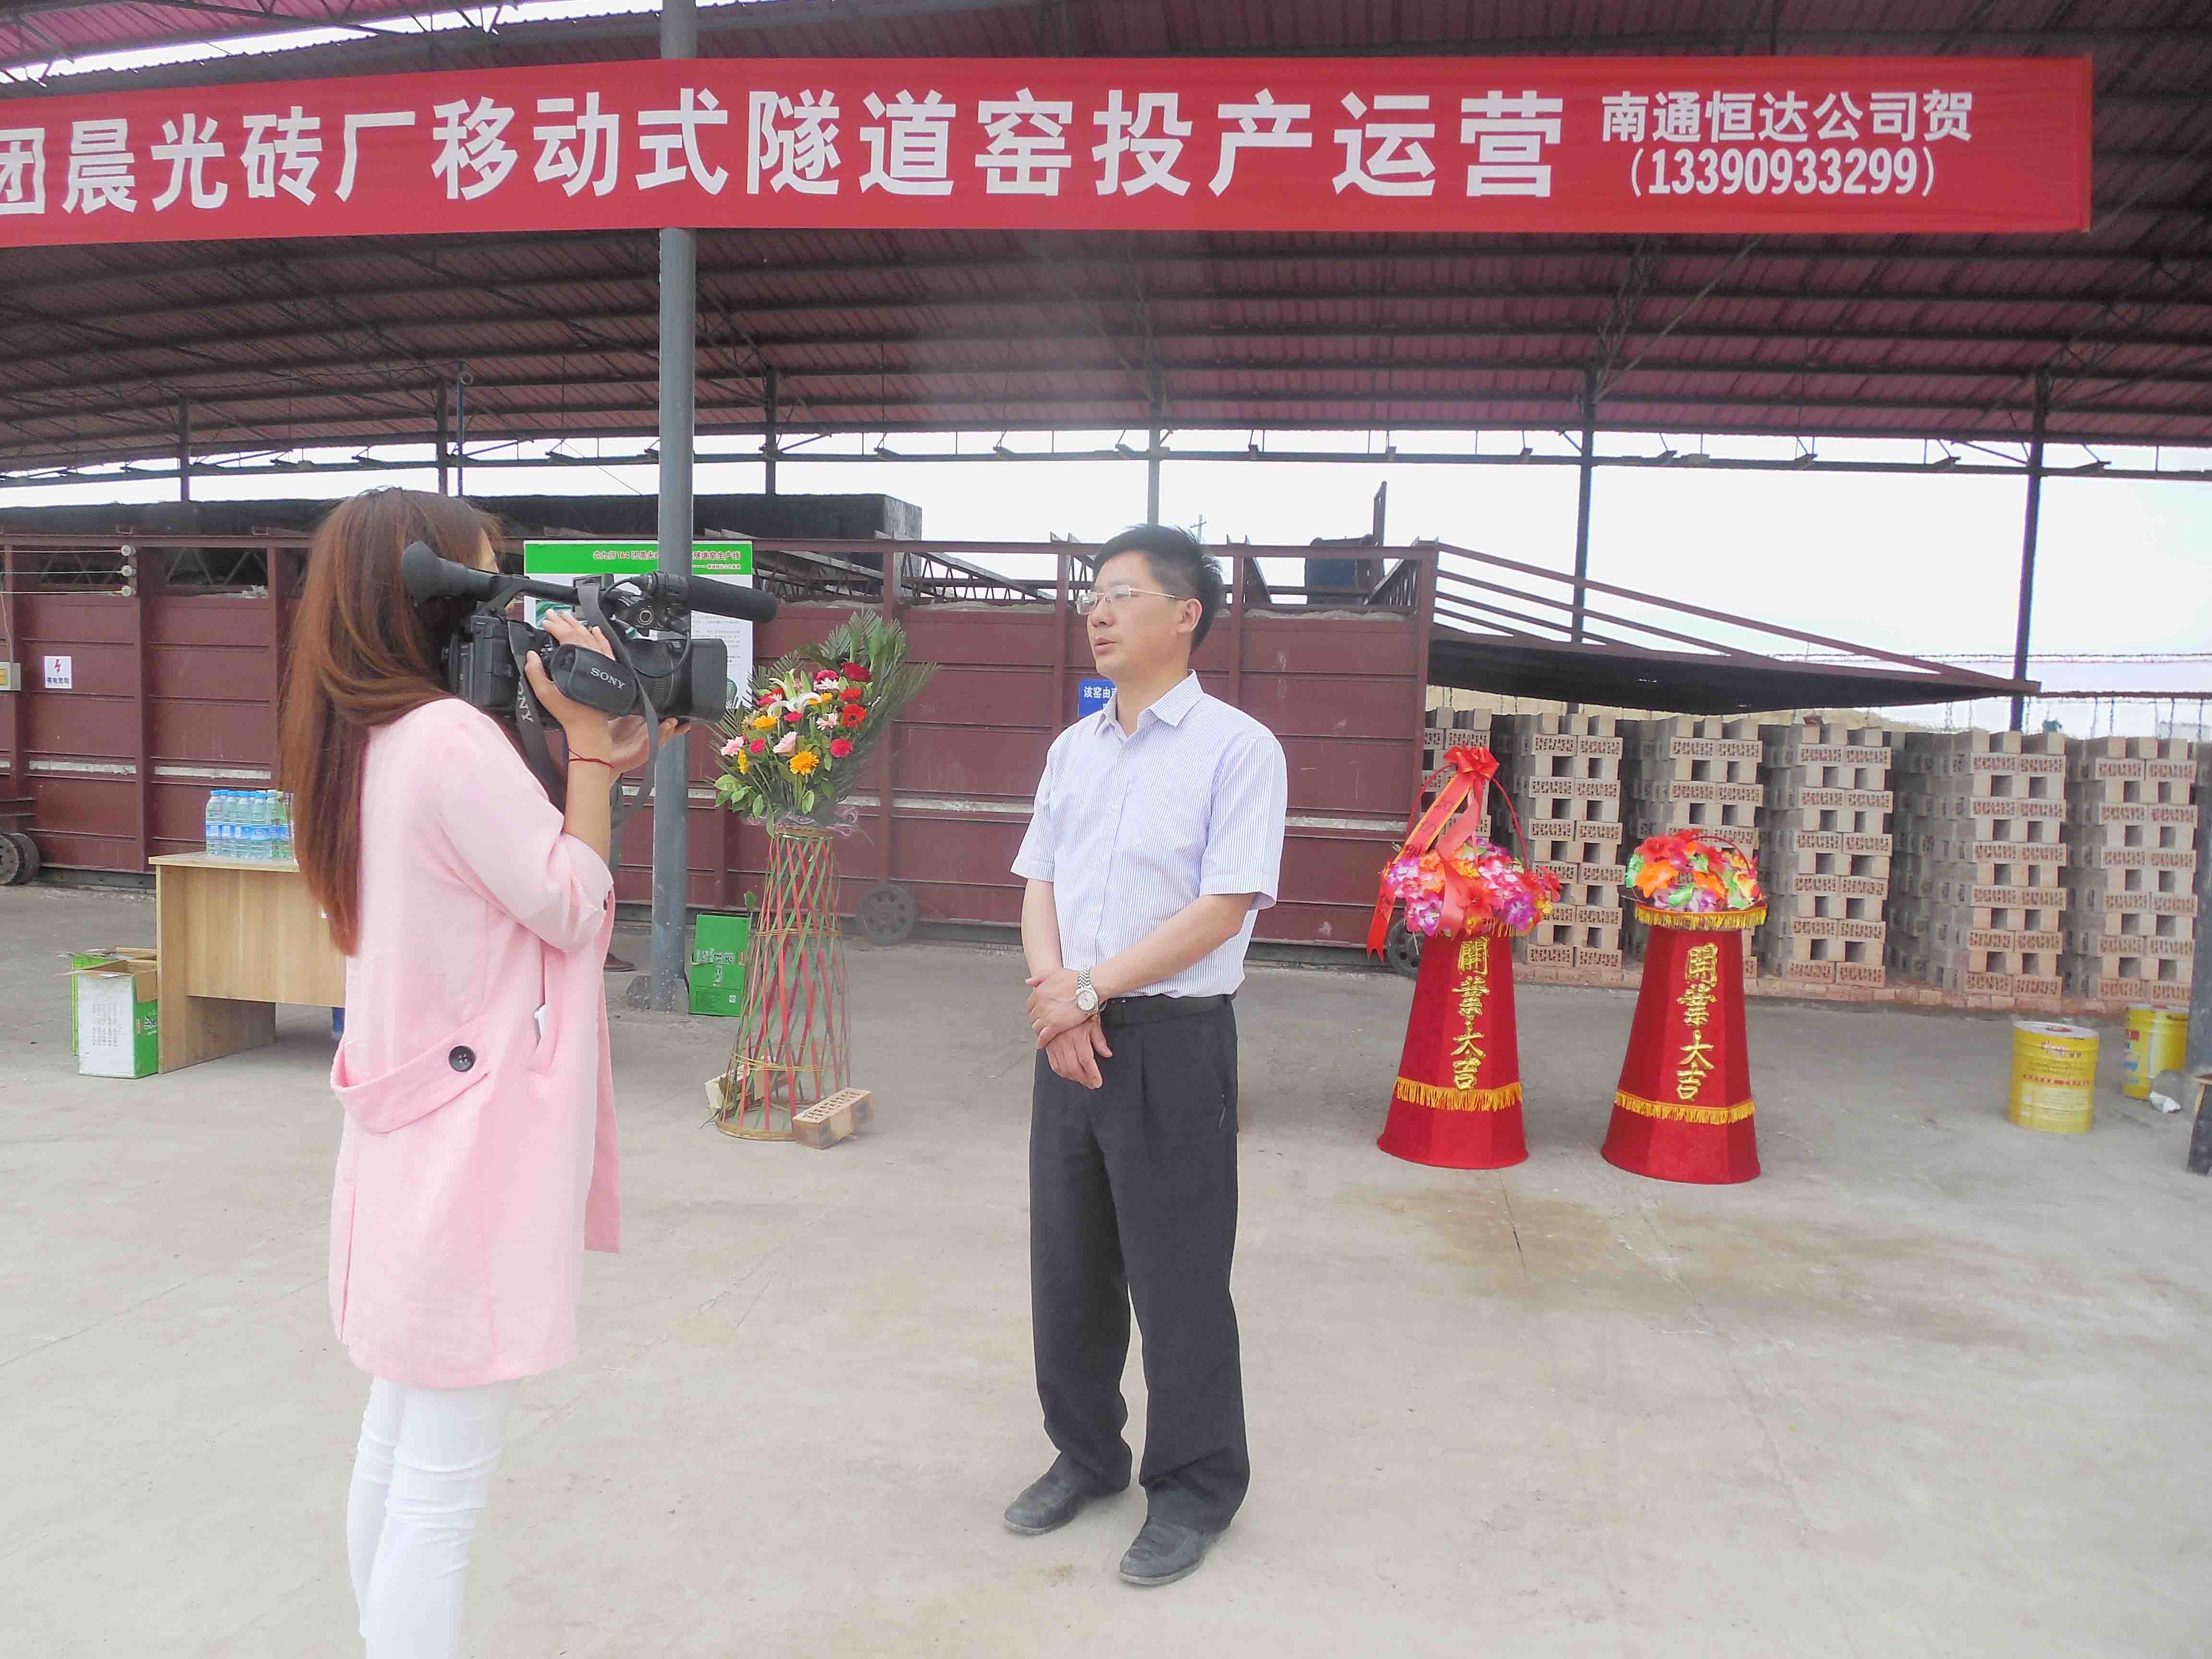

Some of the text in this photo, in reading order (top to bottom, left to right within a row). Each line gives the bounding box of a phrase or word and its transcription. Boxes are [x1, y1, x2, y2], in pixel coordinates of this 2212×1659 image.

[1601, 89, 1973, 143] 南通恒达公司贺
[0, 87, 1563, 215] 团晨光砖厂移动式隧道窑投产运营
[1631, 146, 1935, 197] (13390933299)
[517, 676, 533, 722] ONY
[590, 667, 625, 689] SONY
[1450, 936, 1491, 1091] 開業大吉
[1677, 942, 1719, 1100] 開業大吉
